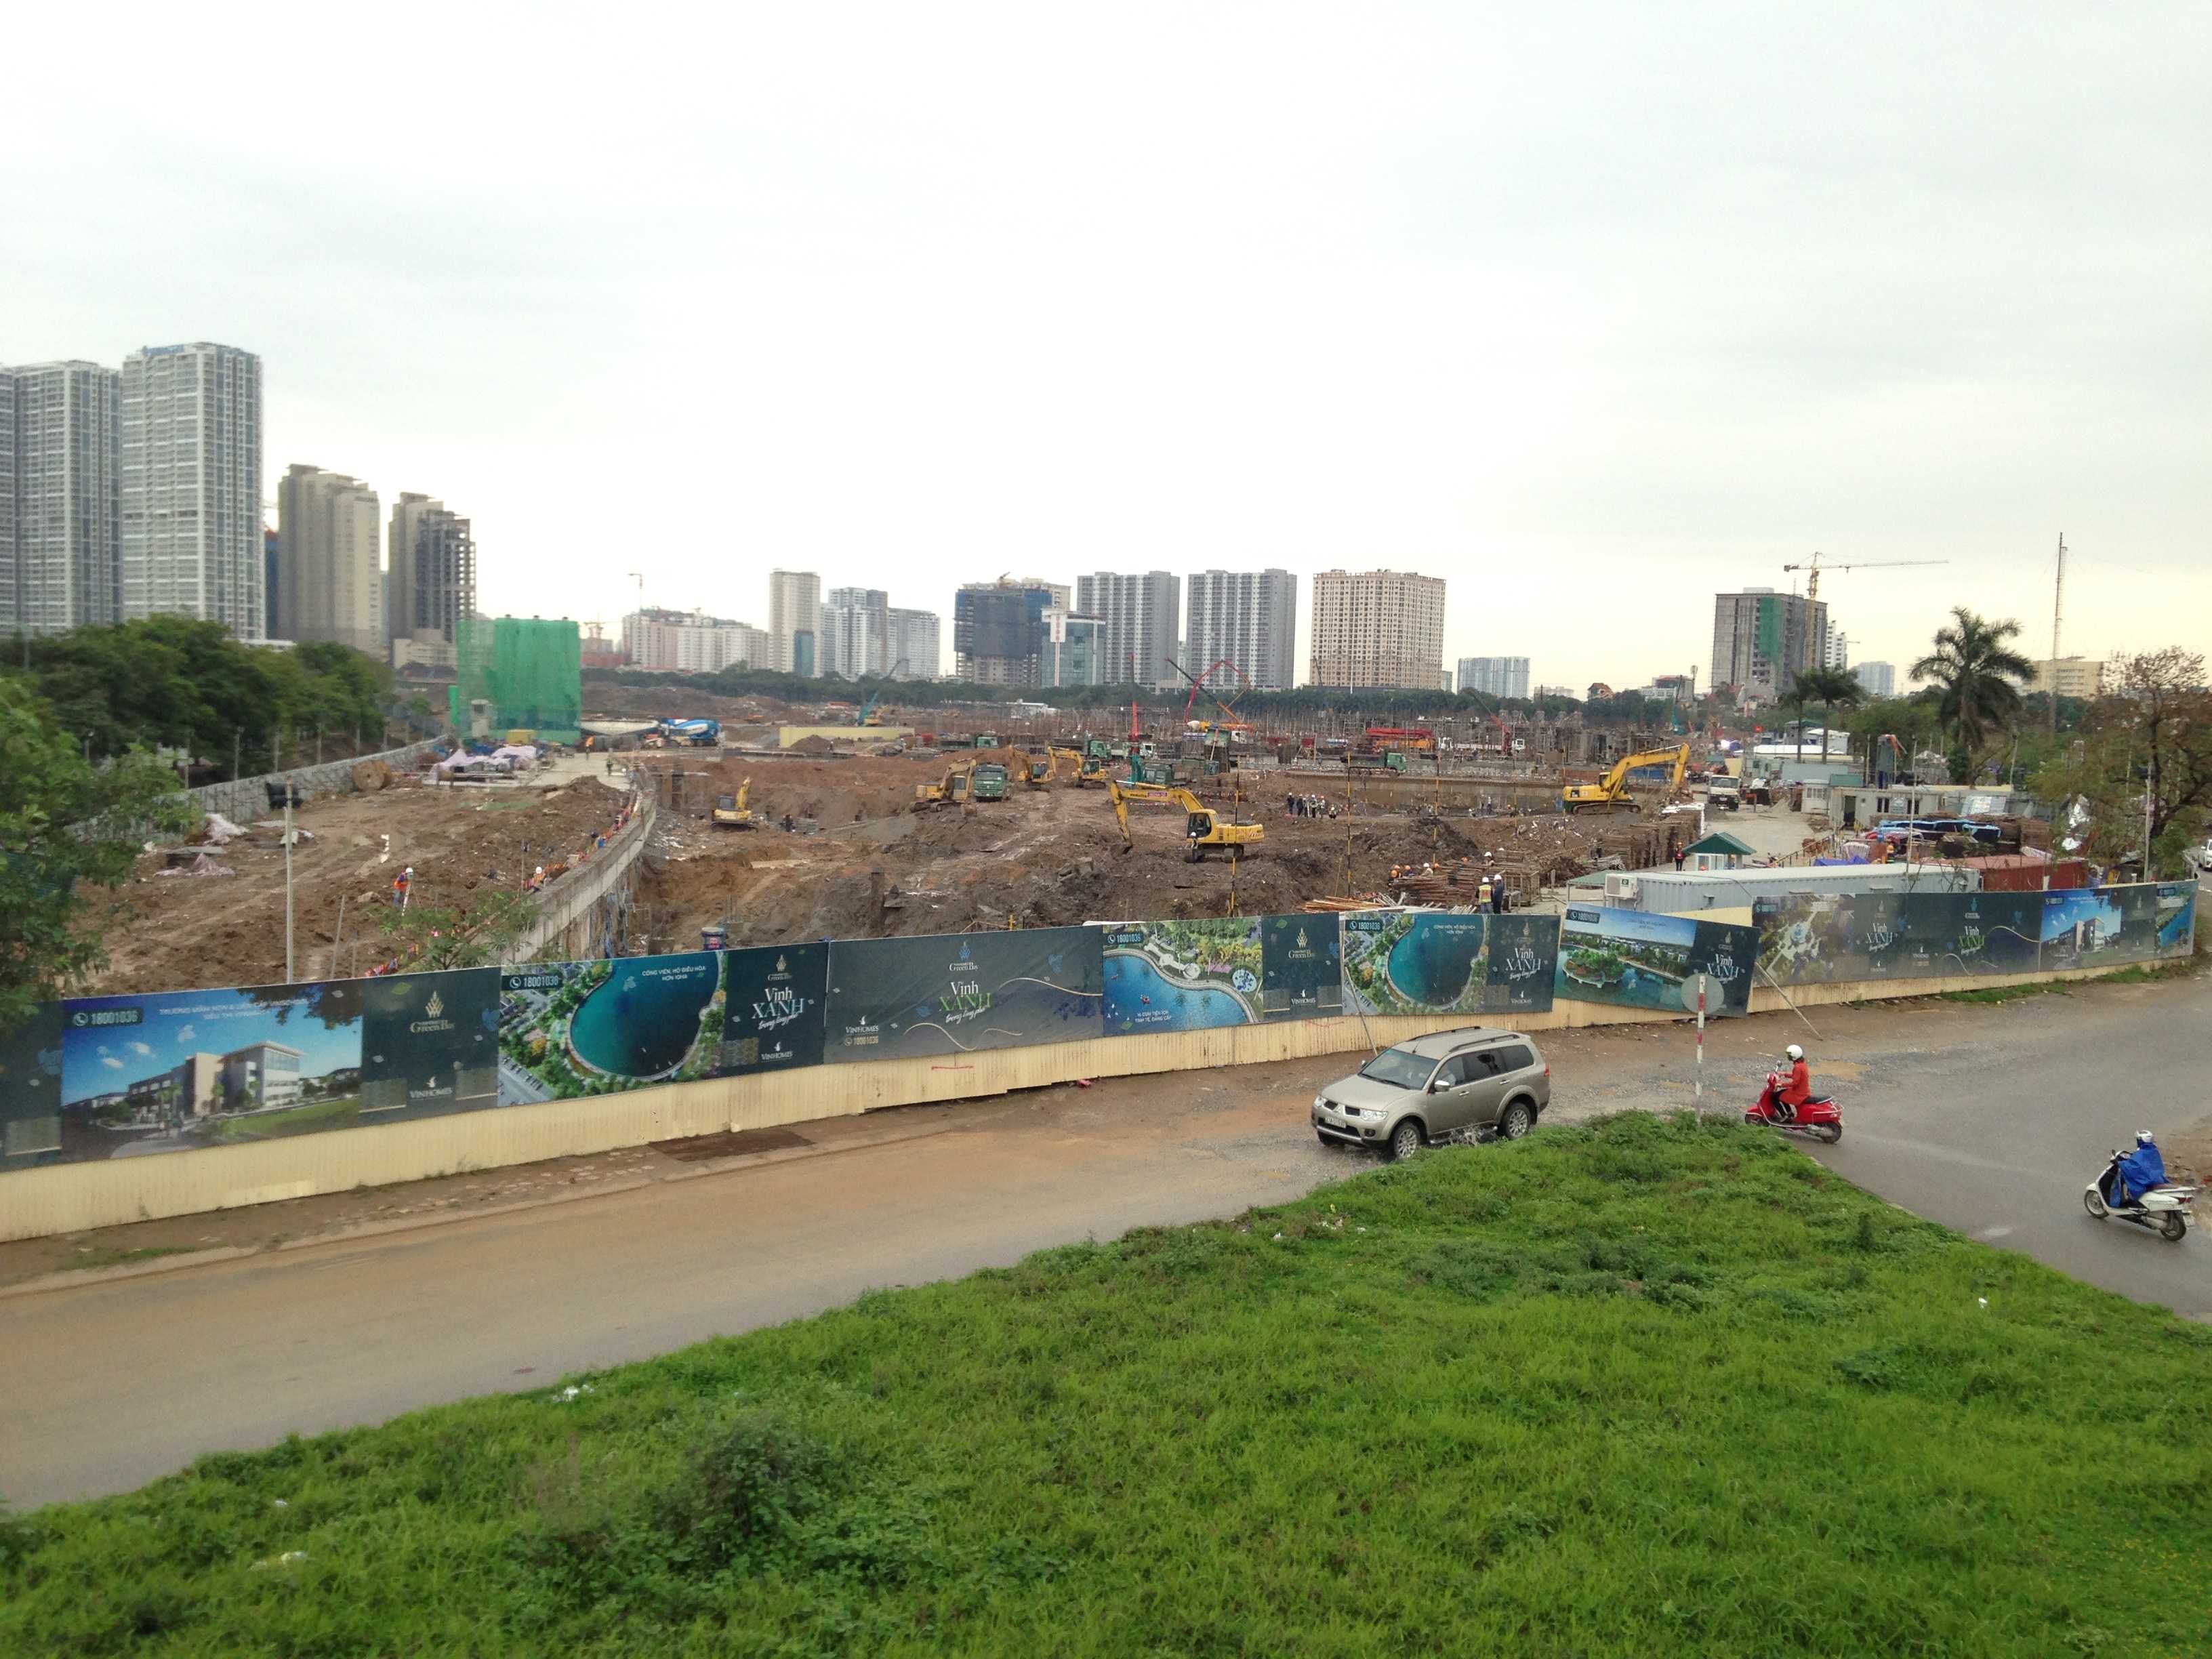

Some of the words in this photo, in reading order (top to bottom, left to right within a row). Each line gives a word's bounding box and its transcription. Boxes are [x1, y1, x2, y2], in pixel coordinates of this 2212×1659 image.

[751, 998, 804, 1019] XANH
[939, 993, 991, 1012] XANH
[761, 1051, 793, 1061] VINHOMES
